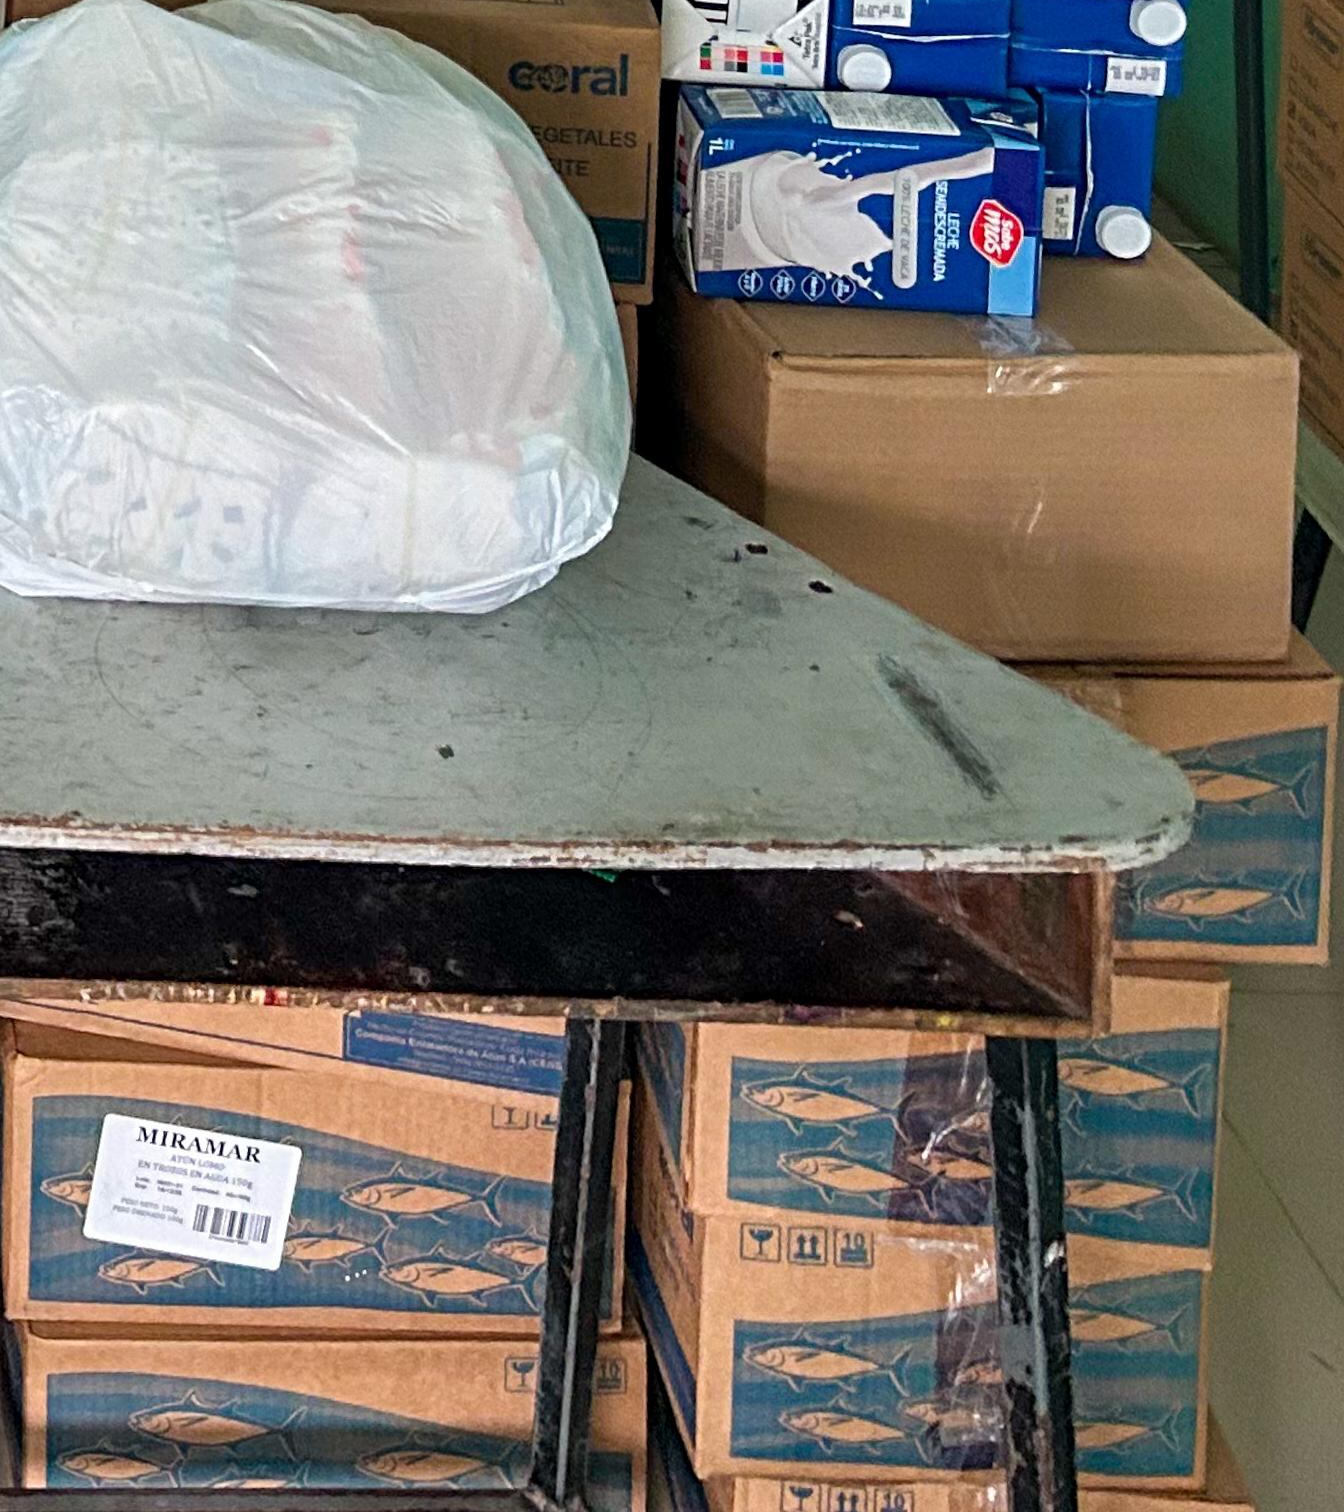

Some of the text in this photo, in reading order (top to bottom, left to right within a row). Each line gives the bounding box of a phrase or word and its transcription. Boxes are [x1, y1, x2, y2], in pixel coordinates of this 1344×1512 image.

[507, 53, 629, 97] coral
[531, 126, 638, 149] EGETALES
[932, 180, 949, 283] SEMIDESCREMADA
[947, 211, 961, 251] LECHE
[999, 217, 1015, 252] Sabe
[136, 1126, 262, 1164] MIRAMAR
[841, 1232, 866, 1249] 10
